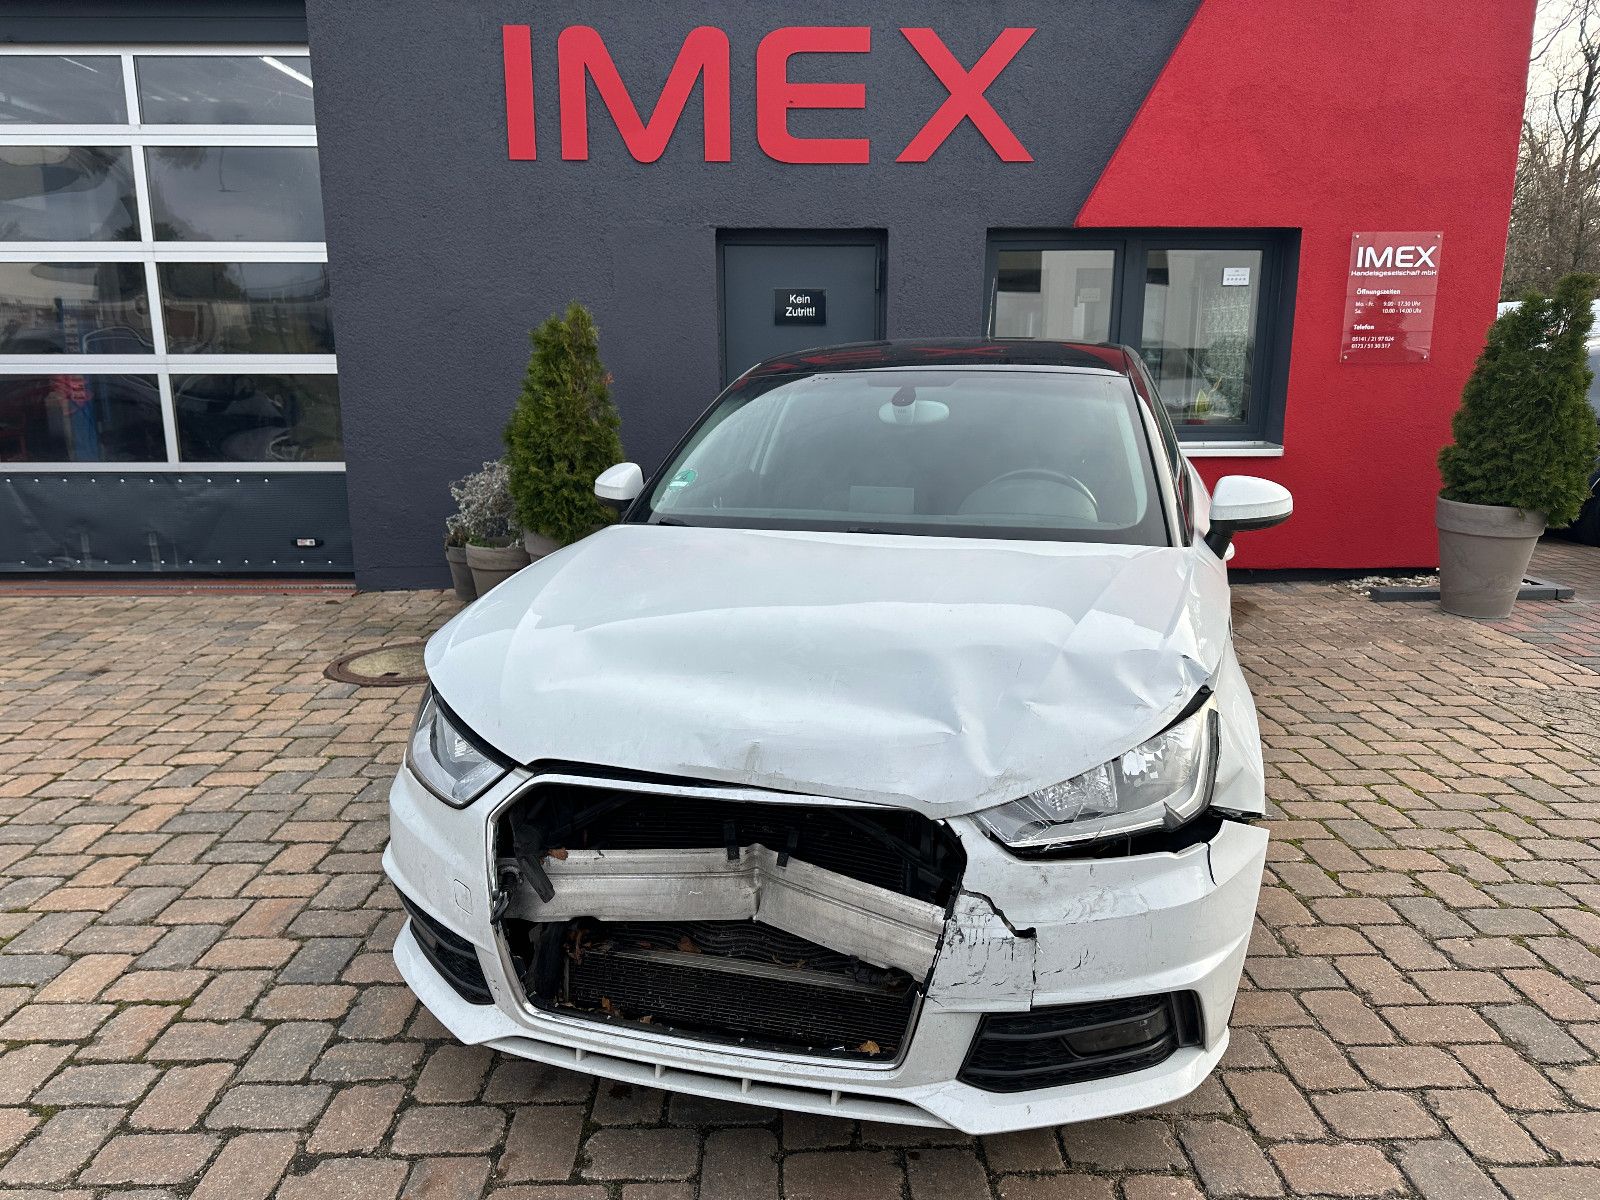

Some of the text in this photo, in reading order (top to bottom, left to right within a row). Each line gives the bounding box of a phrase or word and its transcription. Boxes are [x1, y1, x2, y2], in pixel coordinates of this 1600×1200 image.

[502, 24, 1038, 164] IMEX
[1356, 245, 1437, 268] IMEX
[1356, 288, 1401, 296] Öffnungszeiten
[789, 294, 811, 304] Kein
[785, 306, 816, 317] Zutritt!
